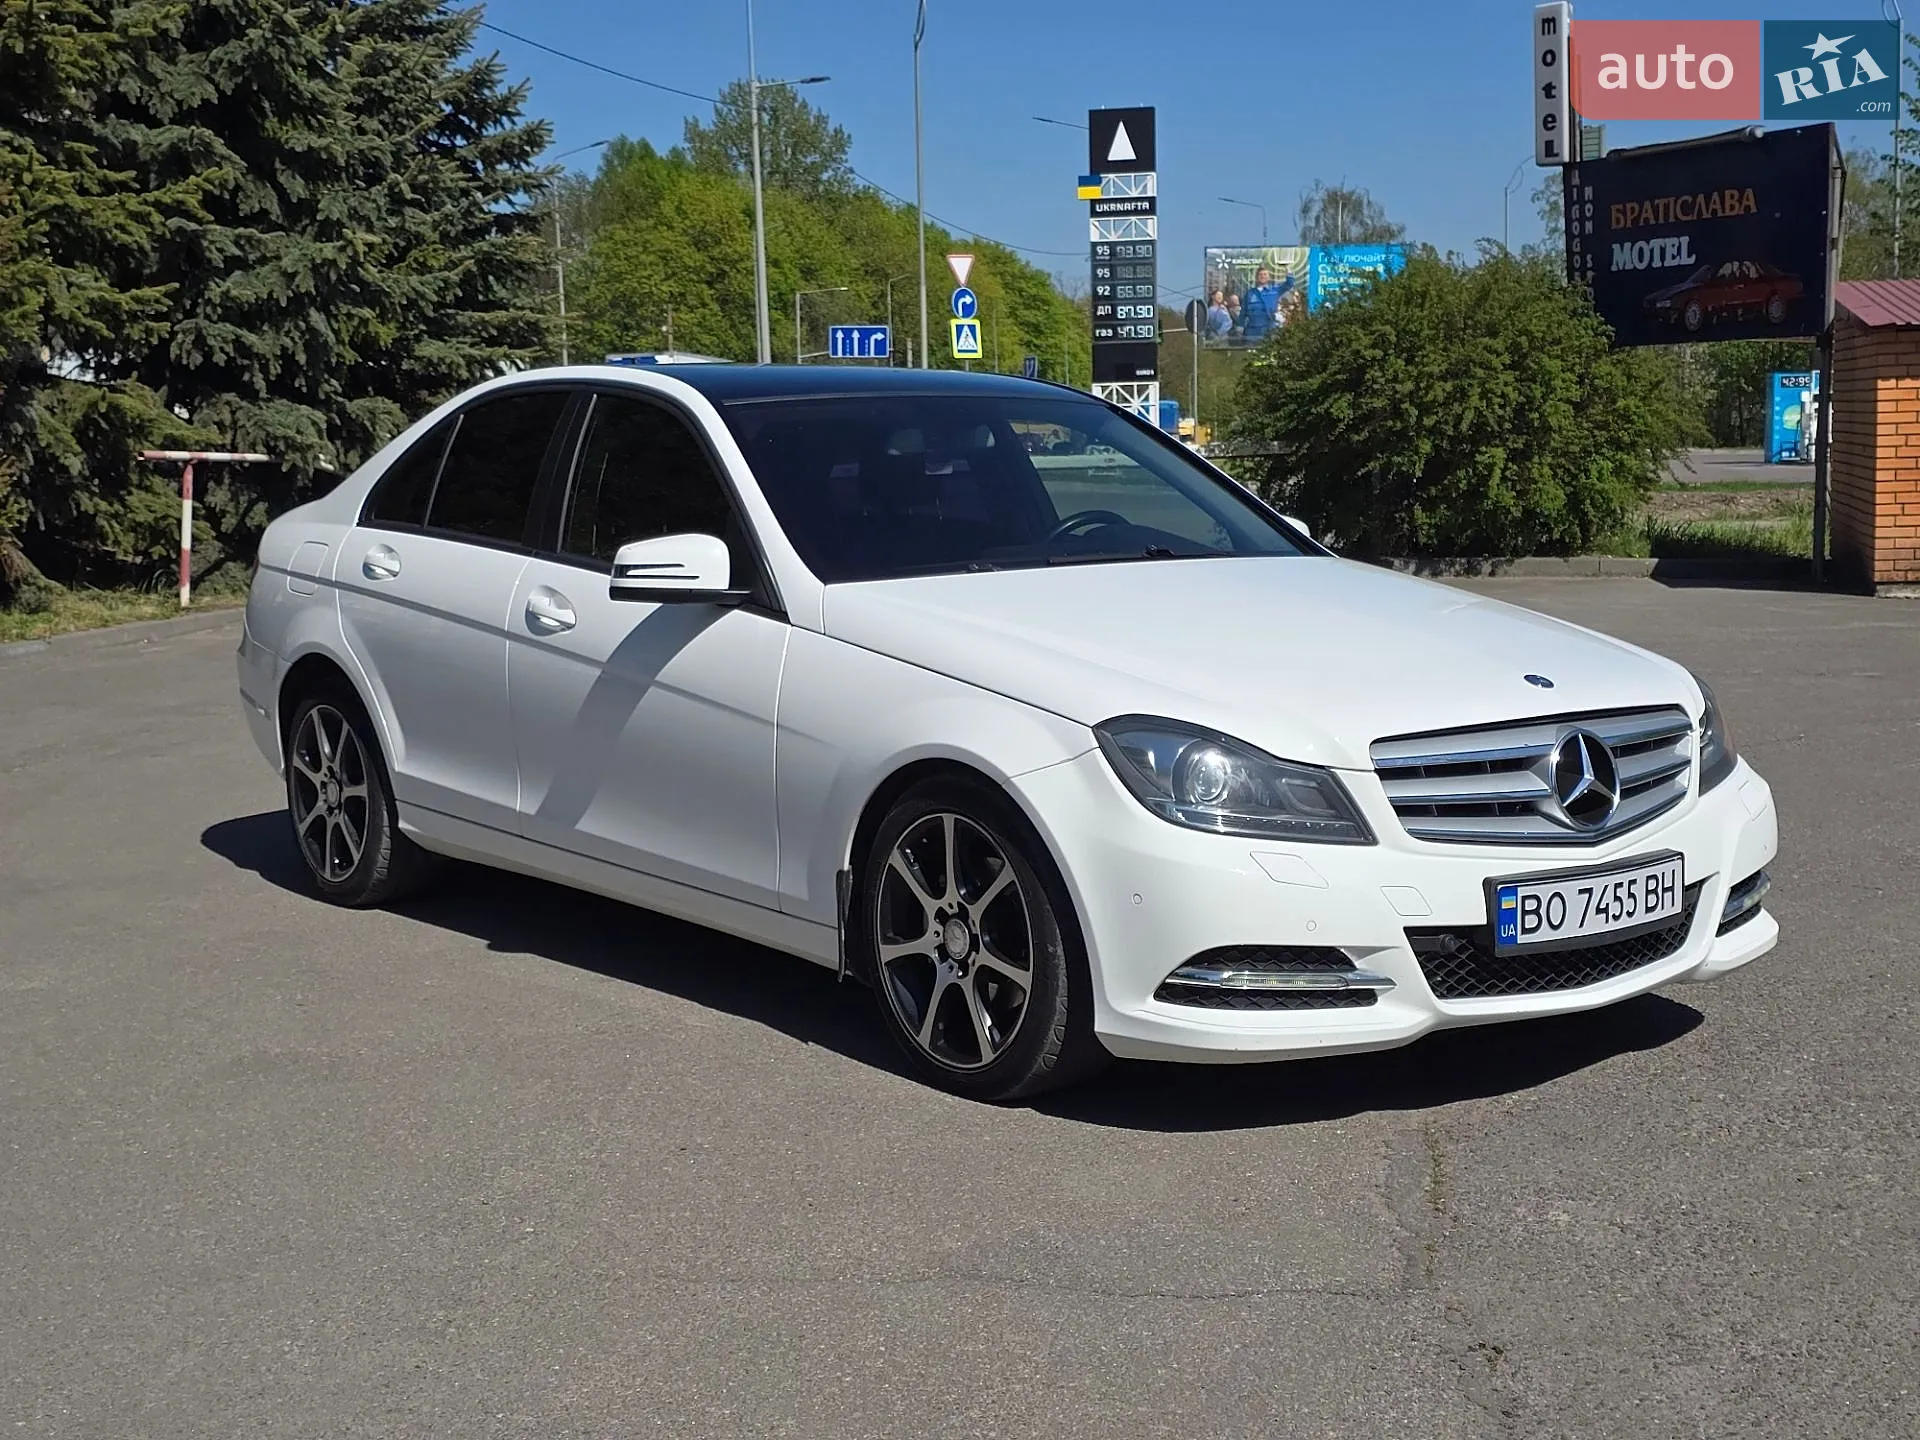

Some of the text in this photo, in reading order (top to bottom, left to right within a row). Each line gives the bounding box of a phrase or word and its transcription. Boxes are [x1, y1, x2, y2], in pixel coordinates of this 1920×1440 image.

[1095, 202, 1150, 212] UKRNAFTA
[1610, 187, 1758, 230] БРАТІСЛАВА
[1096, 245, 1110, 256] 95
[1610, 236, 1697, 271] MOTEL
[1096, 267, 1111, 278] 95
[1096, 285, 1111, 296] 92
[1095, 325, 1154, 338] газ 47.90
[1520, 869, 1676, 935] BO 7455 BH
[1501, 923, 1516, 937] UA
